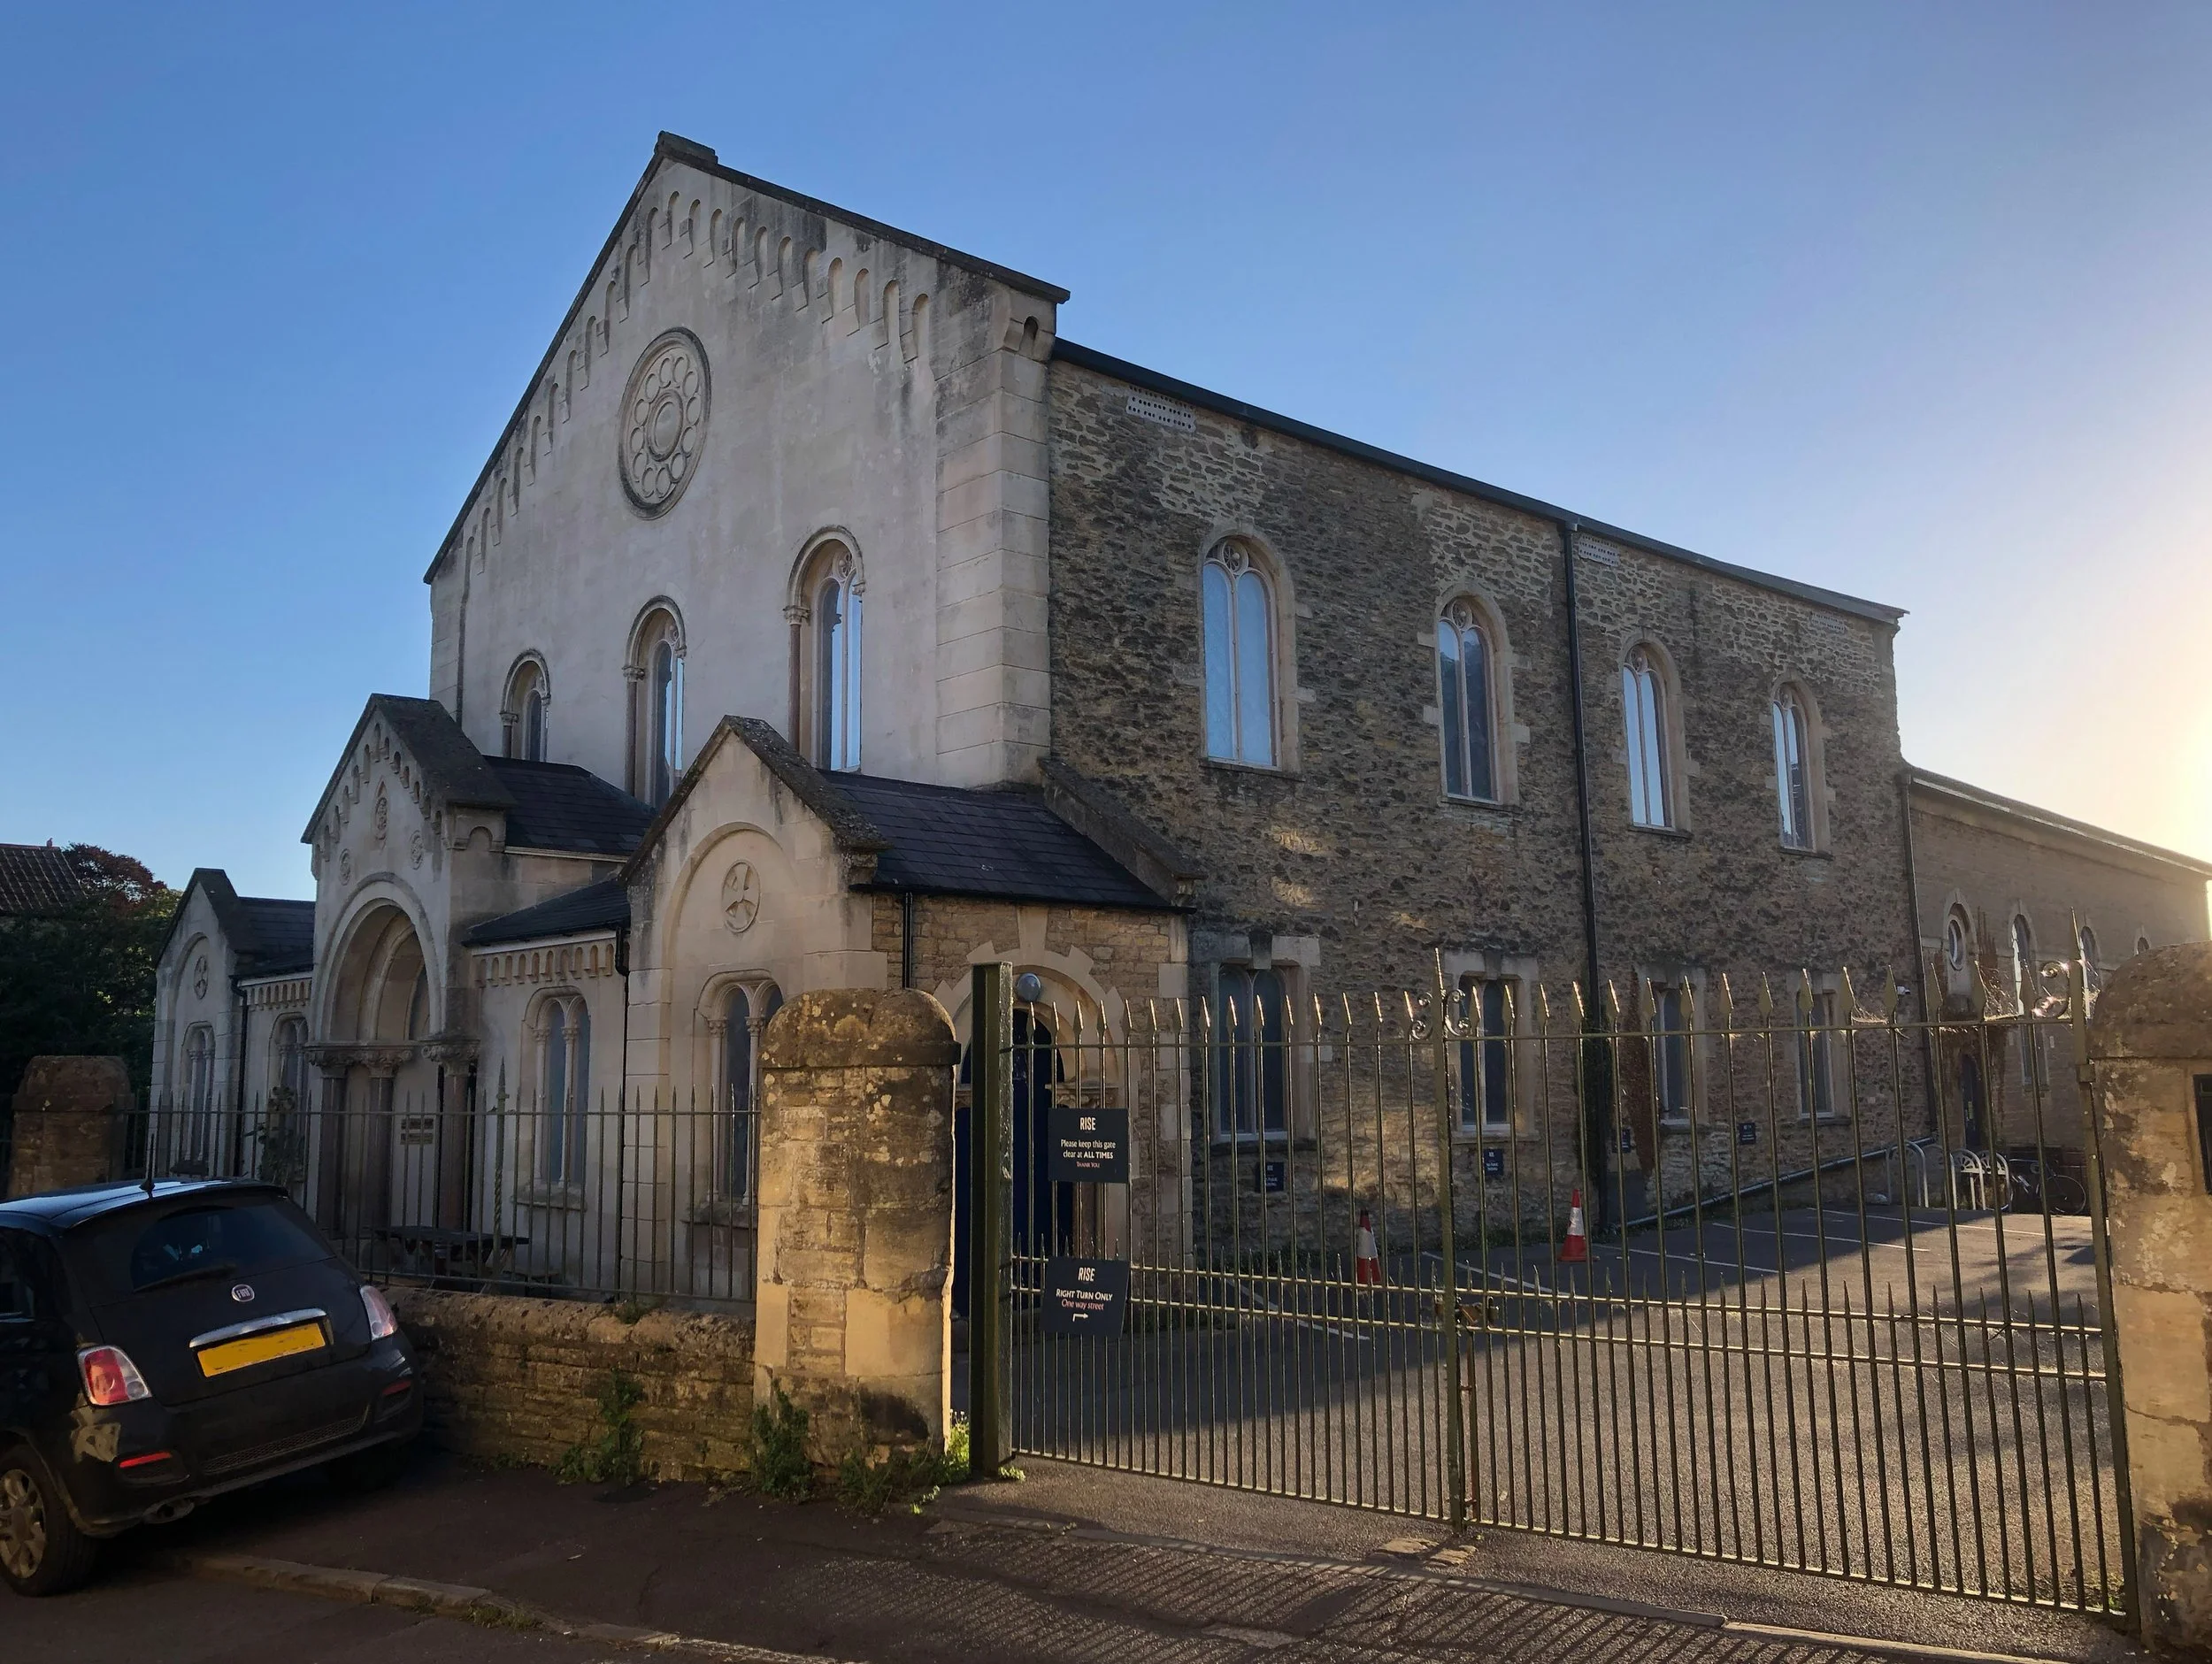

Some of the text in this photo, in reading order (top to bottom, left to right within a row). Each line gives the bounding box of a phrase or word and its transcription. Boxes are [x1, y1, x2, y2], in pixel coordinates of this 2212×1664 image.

[1079, 1116, 1096, 1131] RISE
[1078, 1139, 1092, 1149] keep
[1103, 1141, 1117, 1150] gate
[1078, 1267, 1095, 1282] RISE
[1056, 1288, 1113, 1301] RIGHT TURN ONLY
[1062, 1298, 1104, 1311] One way street
